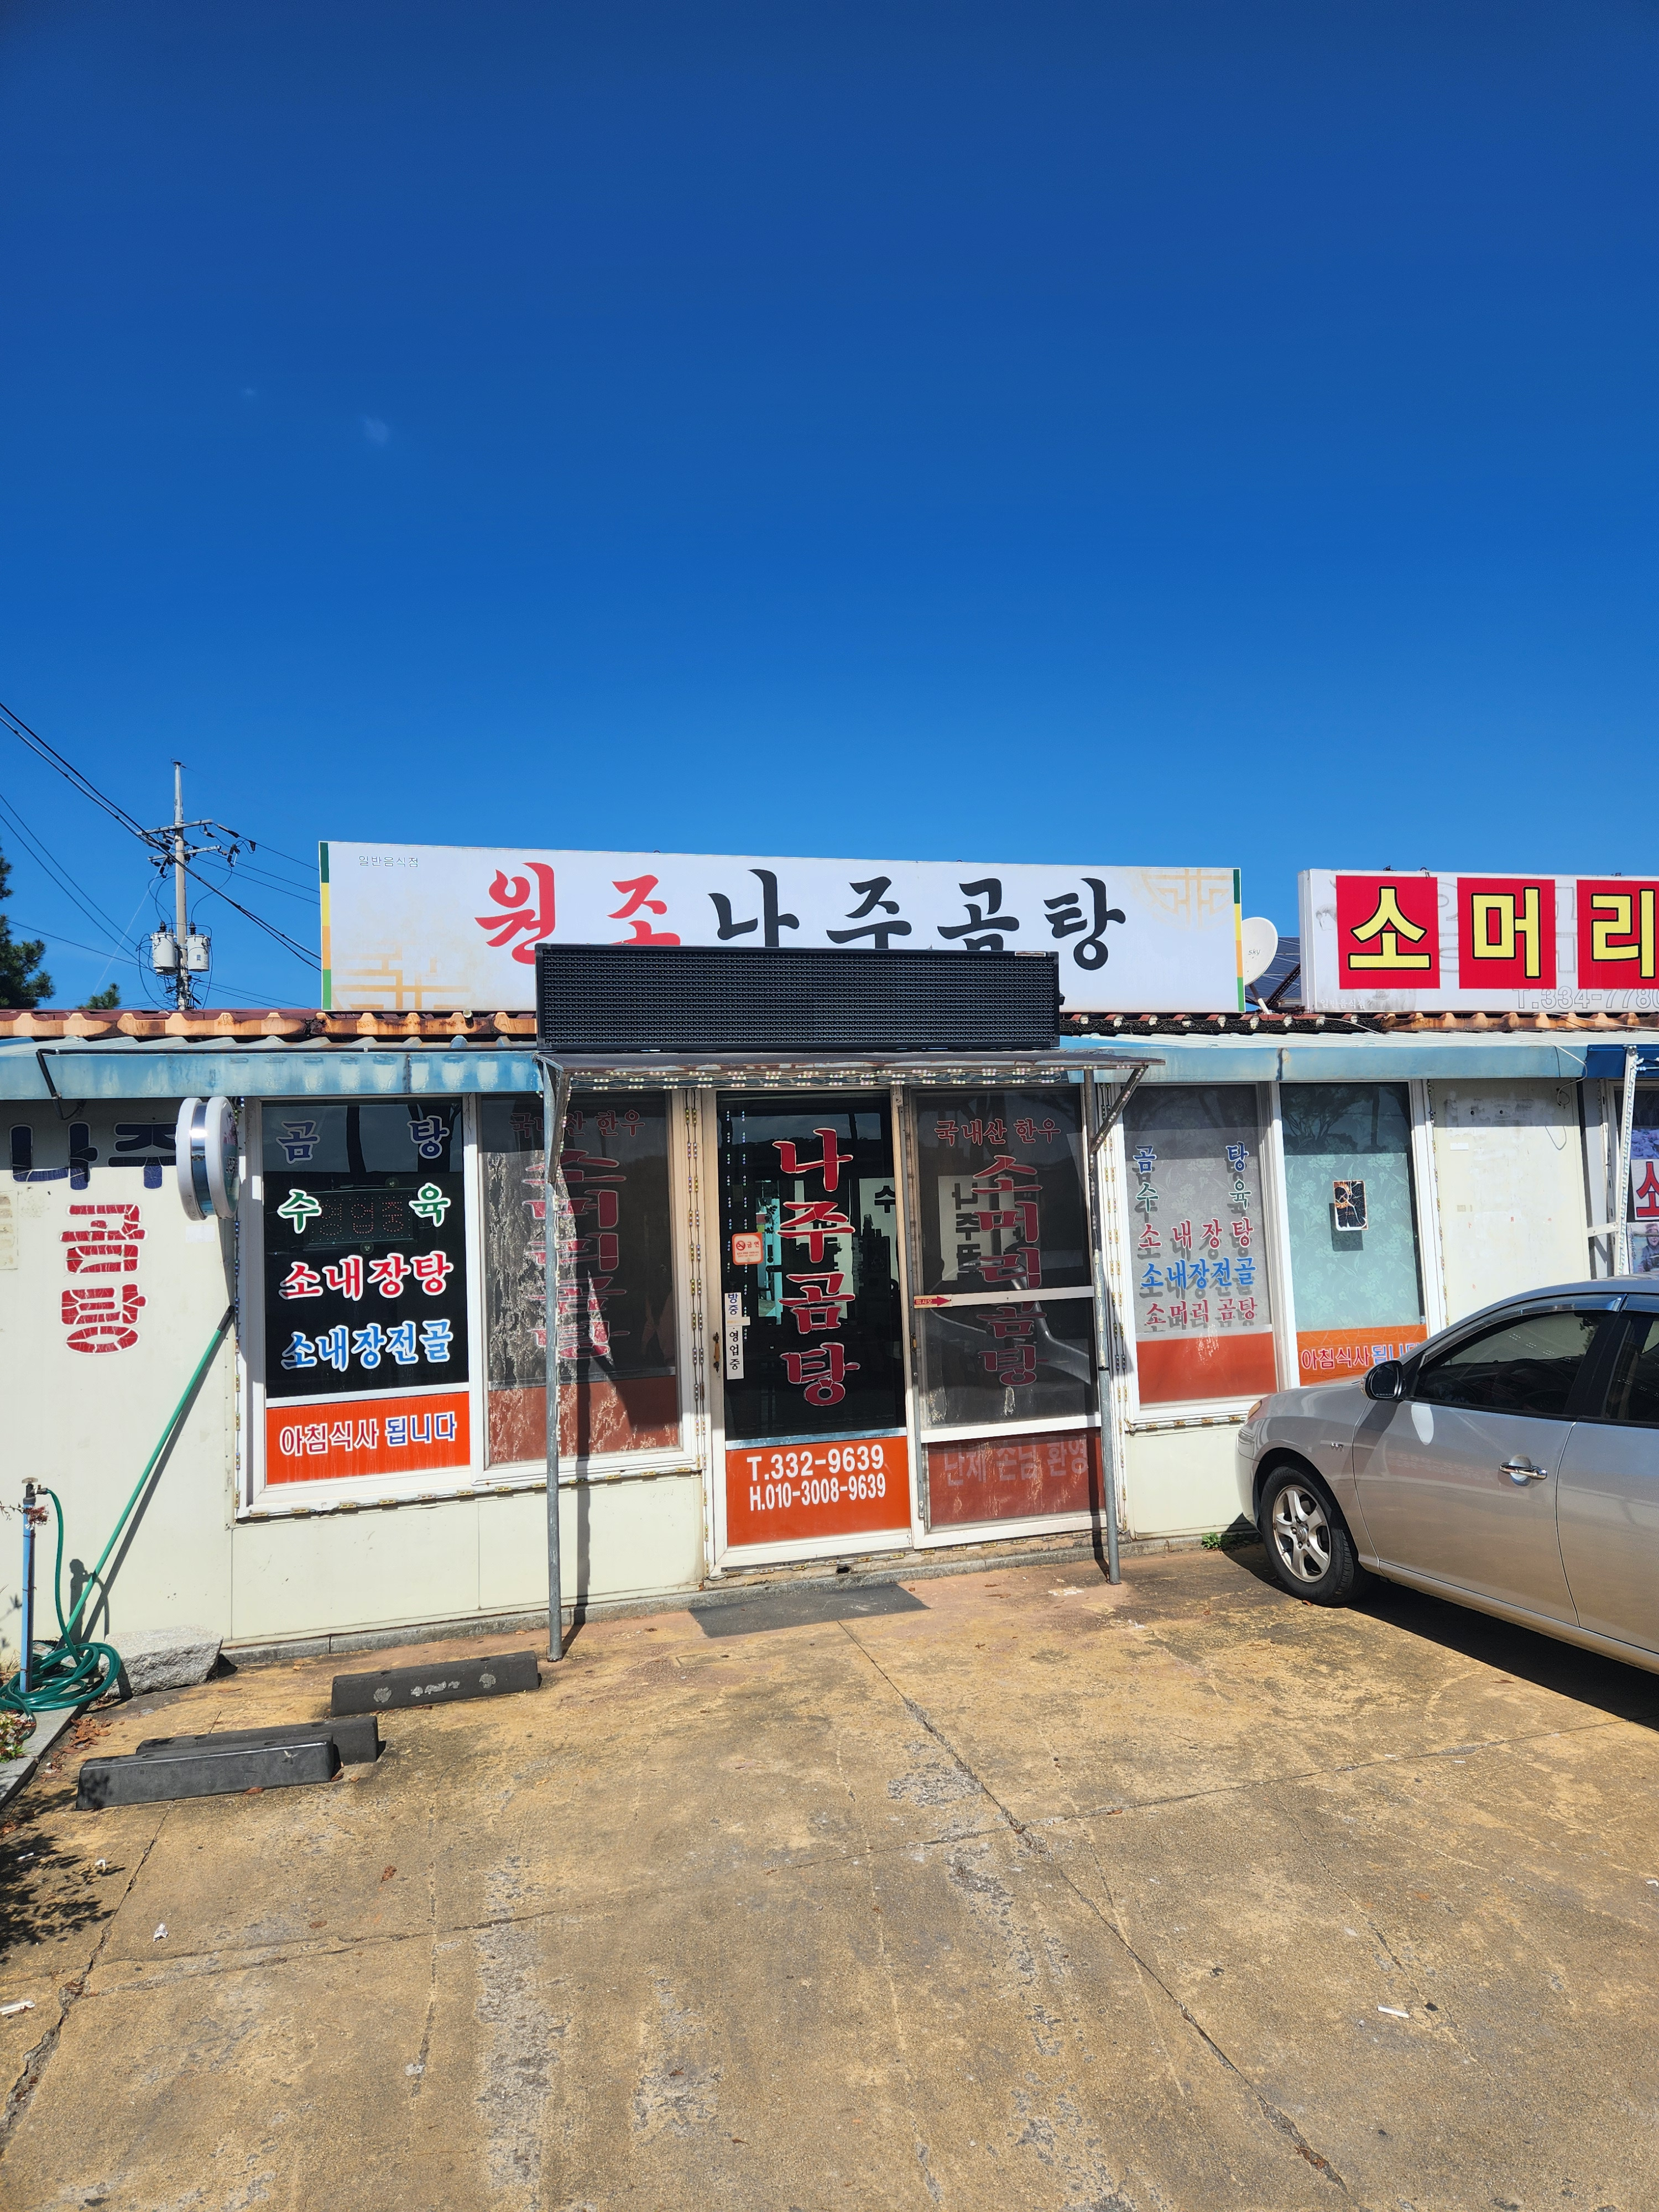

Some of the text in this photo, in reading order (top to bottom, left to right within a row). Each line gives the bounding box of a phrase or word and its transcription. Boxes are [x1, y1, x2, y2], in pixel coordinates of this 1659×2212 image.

[358, 855, 419, 868] 일반음식점
[1348, 886, 1656, 979] 소머리
[594, 1109, 645, 1136] 한우
[934, 1118, 1061, 1146] 국내산 한우
[319, 1201, 404, 1237] 영업중
[279, 1250, 454, 1301] 소내장탕
[771, 1127, 861, 1406] 나주곰탕
[1140, 1257, 1256, 1290] 소내장전골
[1146, 1296, 1258, 1325] 소머리 곰탕
[281, 1318, 453, 1372] 소내장전골
[729, 1331, 740, 1370] 영업중
[1302, 1345, 1370, 1370] 아침식사
[279, 1411, 457, 1457] 아침식사 됩니다
[747, 1444, 884, 1481] T.332-9639
[750, 1473, 885, 1511] H.010-3008-9639
